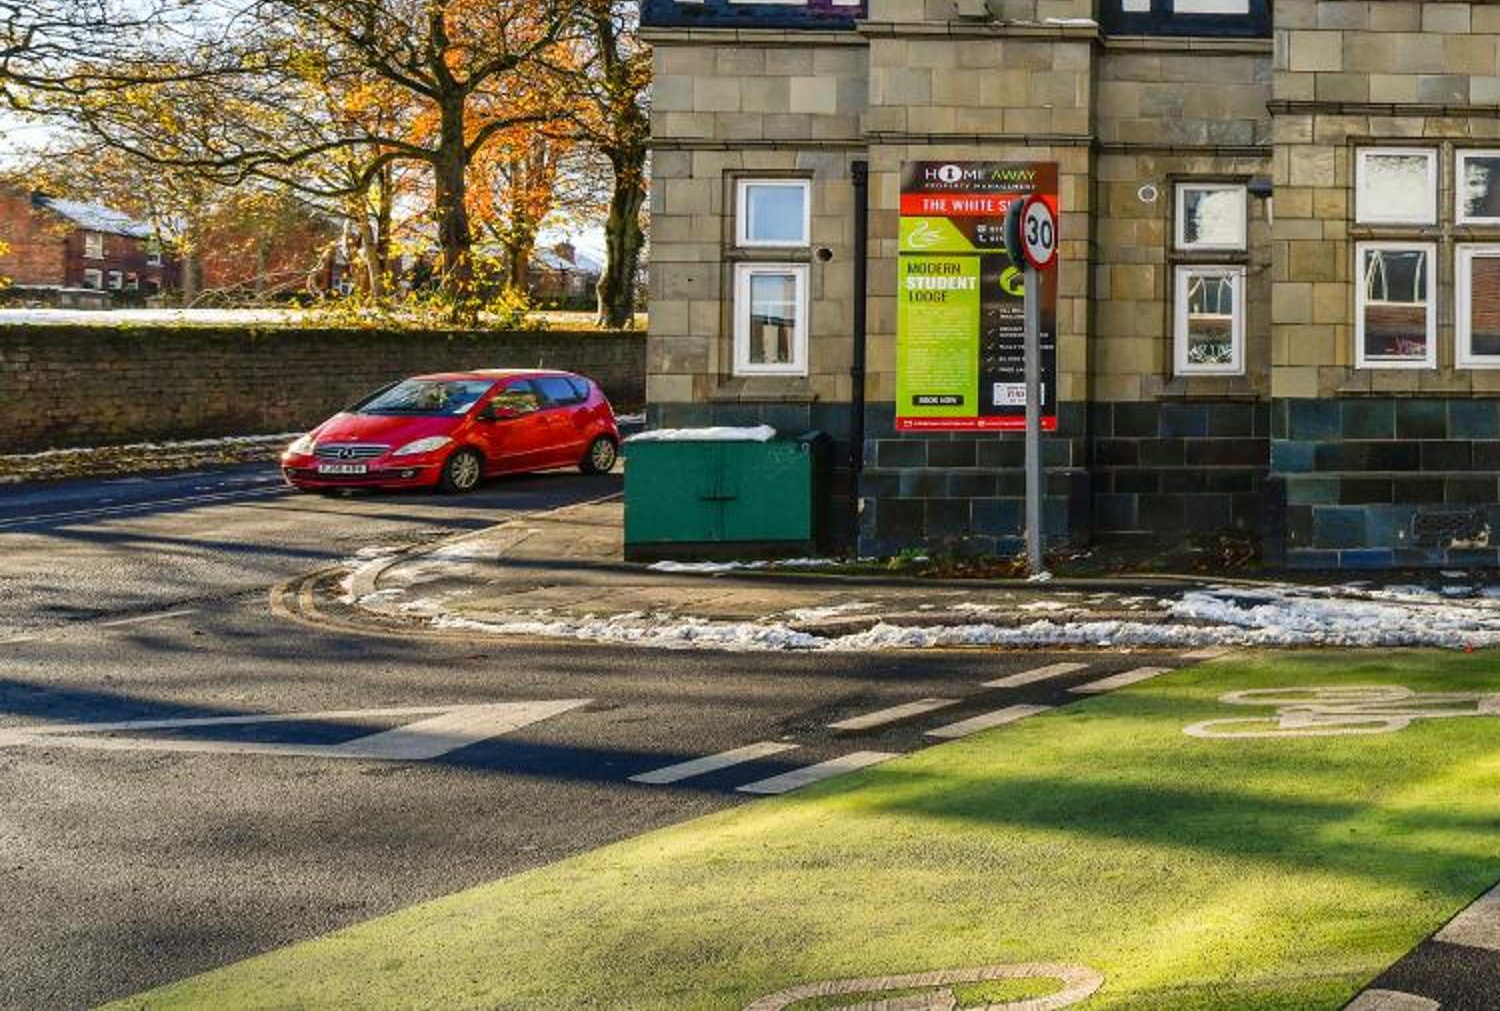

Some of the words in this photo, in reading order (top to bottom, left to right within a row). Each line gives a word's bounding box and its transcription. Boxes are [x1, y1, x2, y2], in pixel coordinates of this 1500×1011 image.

[990, 170, 1036, 182] AWAY
[922, 198, 946, 211] THE
[952, 199, 994, 211] WHITE
[1026, 215, 1053, 249] 30
[907, 262, 961, 275] MODERN
[906, 276, 977, 290] STUDENT
[908, 290, 948, 302] LODGE
